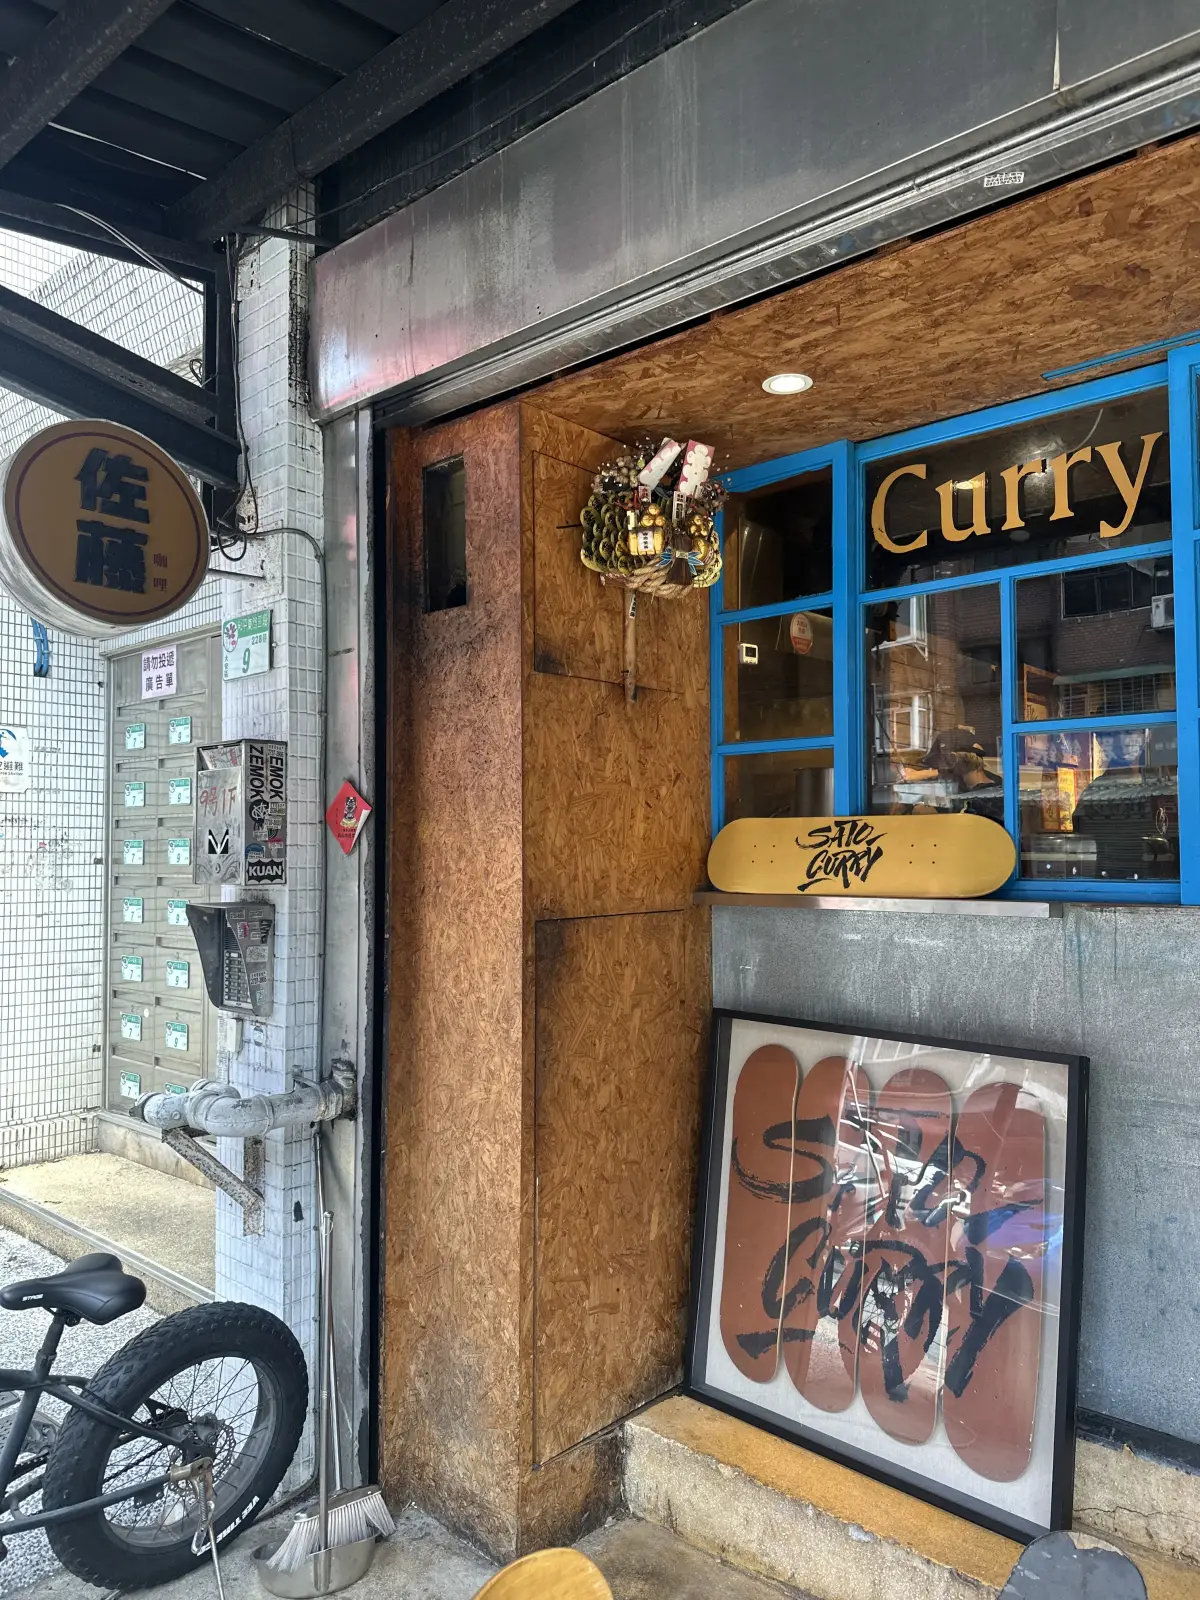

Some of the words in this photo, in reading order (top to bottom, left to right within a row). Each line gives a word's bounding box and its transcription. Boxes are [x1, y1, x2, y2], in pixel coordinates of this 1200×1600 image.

[871, 431, 1163, 554] Curry
[74, 447, 150, 594] 佐藤
[143, 651, 175, 671] 請勿投遞
[242, 648, 251, 673] 9
[146, 672, 173, 692] 廣告單
[250, 744, 264, 799] ZEMOK
[269, 755, 284, 801] EMOK
[795, 818, 888, 850] SATO
[249, 865, 282, 876] KUAN
[797, 846, 883, 892] CURRY
[732, 1108, 1043, 1246] SATO
[736, 1239, 1034, 1404] CURRY
[241, 1495, 260, 1519] VEE
[215, 1517, 241, 1543] TIRE
